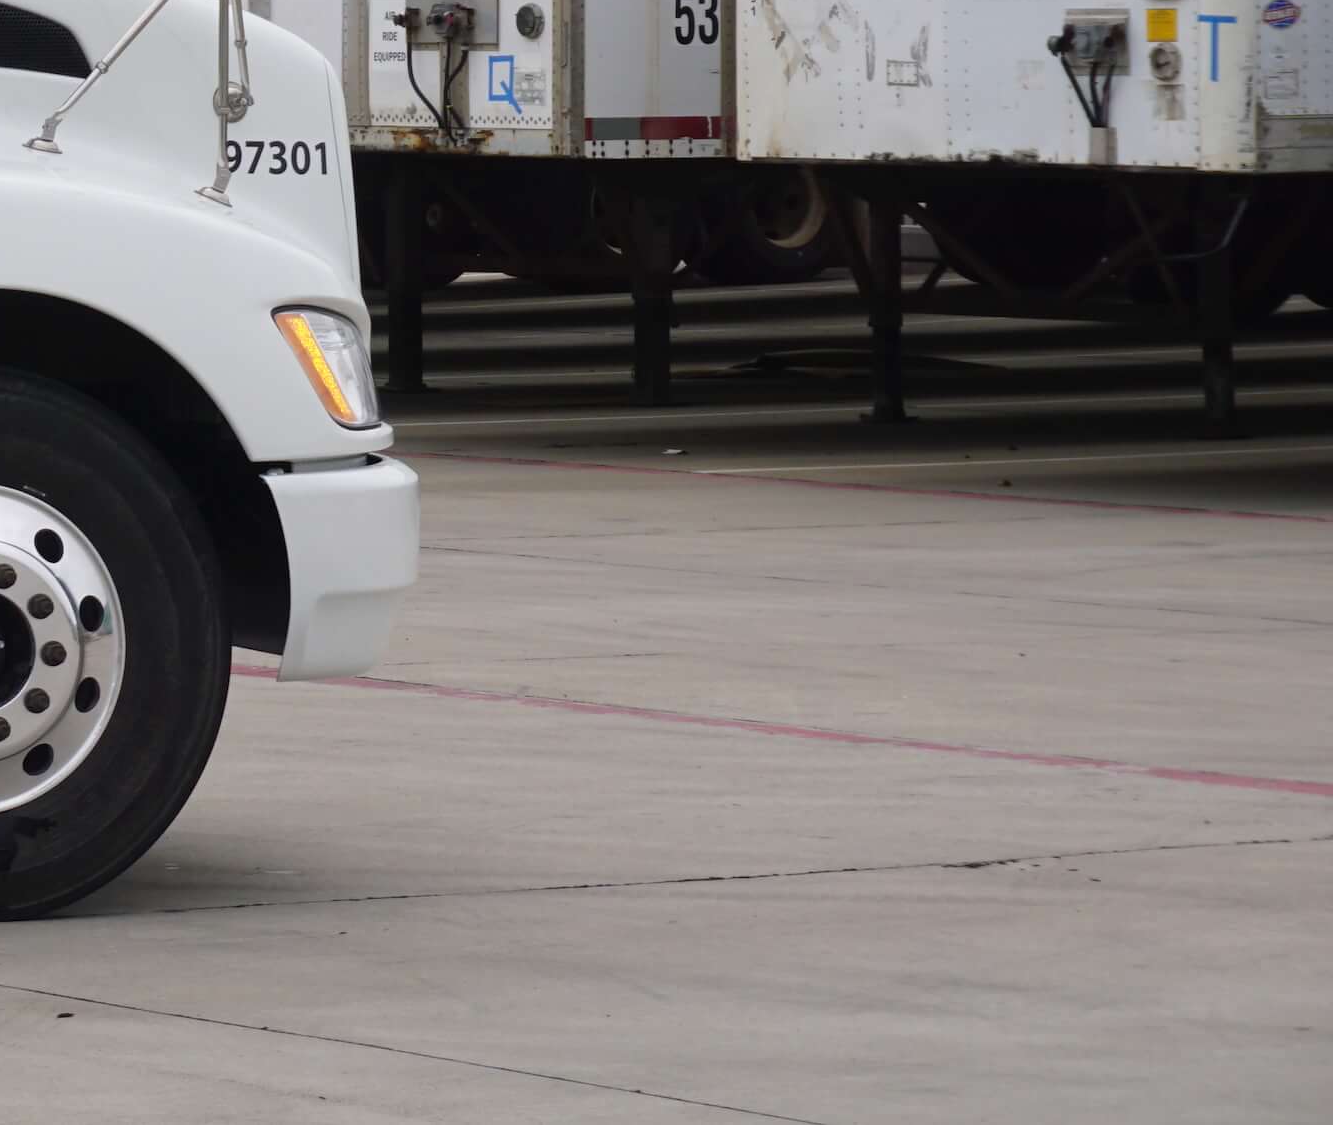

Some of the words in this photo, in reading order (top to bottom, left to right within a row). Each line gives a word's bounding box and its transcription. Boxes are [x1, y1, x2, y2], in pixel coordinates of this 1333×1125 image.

[382, 31, 398, 42] RIDE
[373, 51, 406, 63] EQUIPPED
[488, 55, 522, 114] Q
[225, 140, 327, 175] 97301
